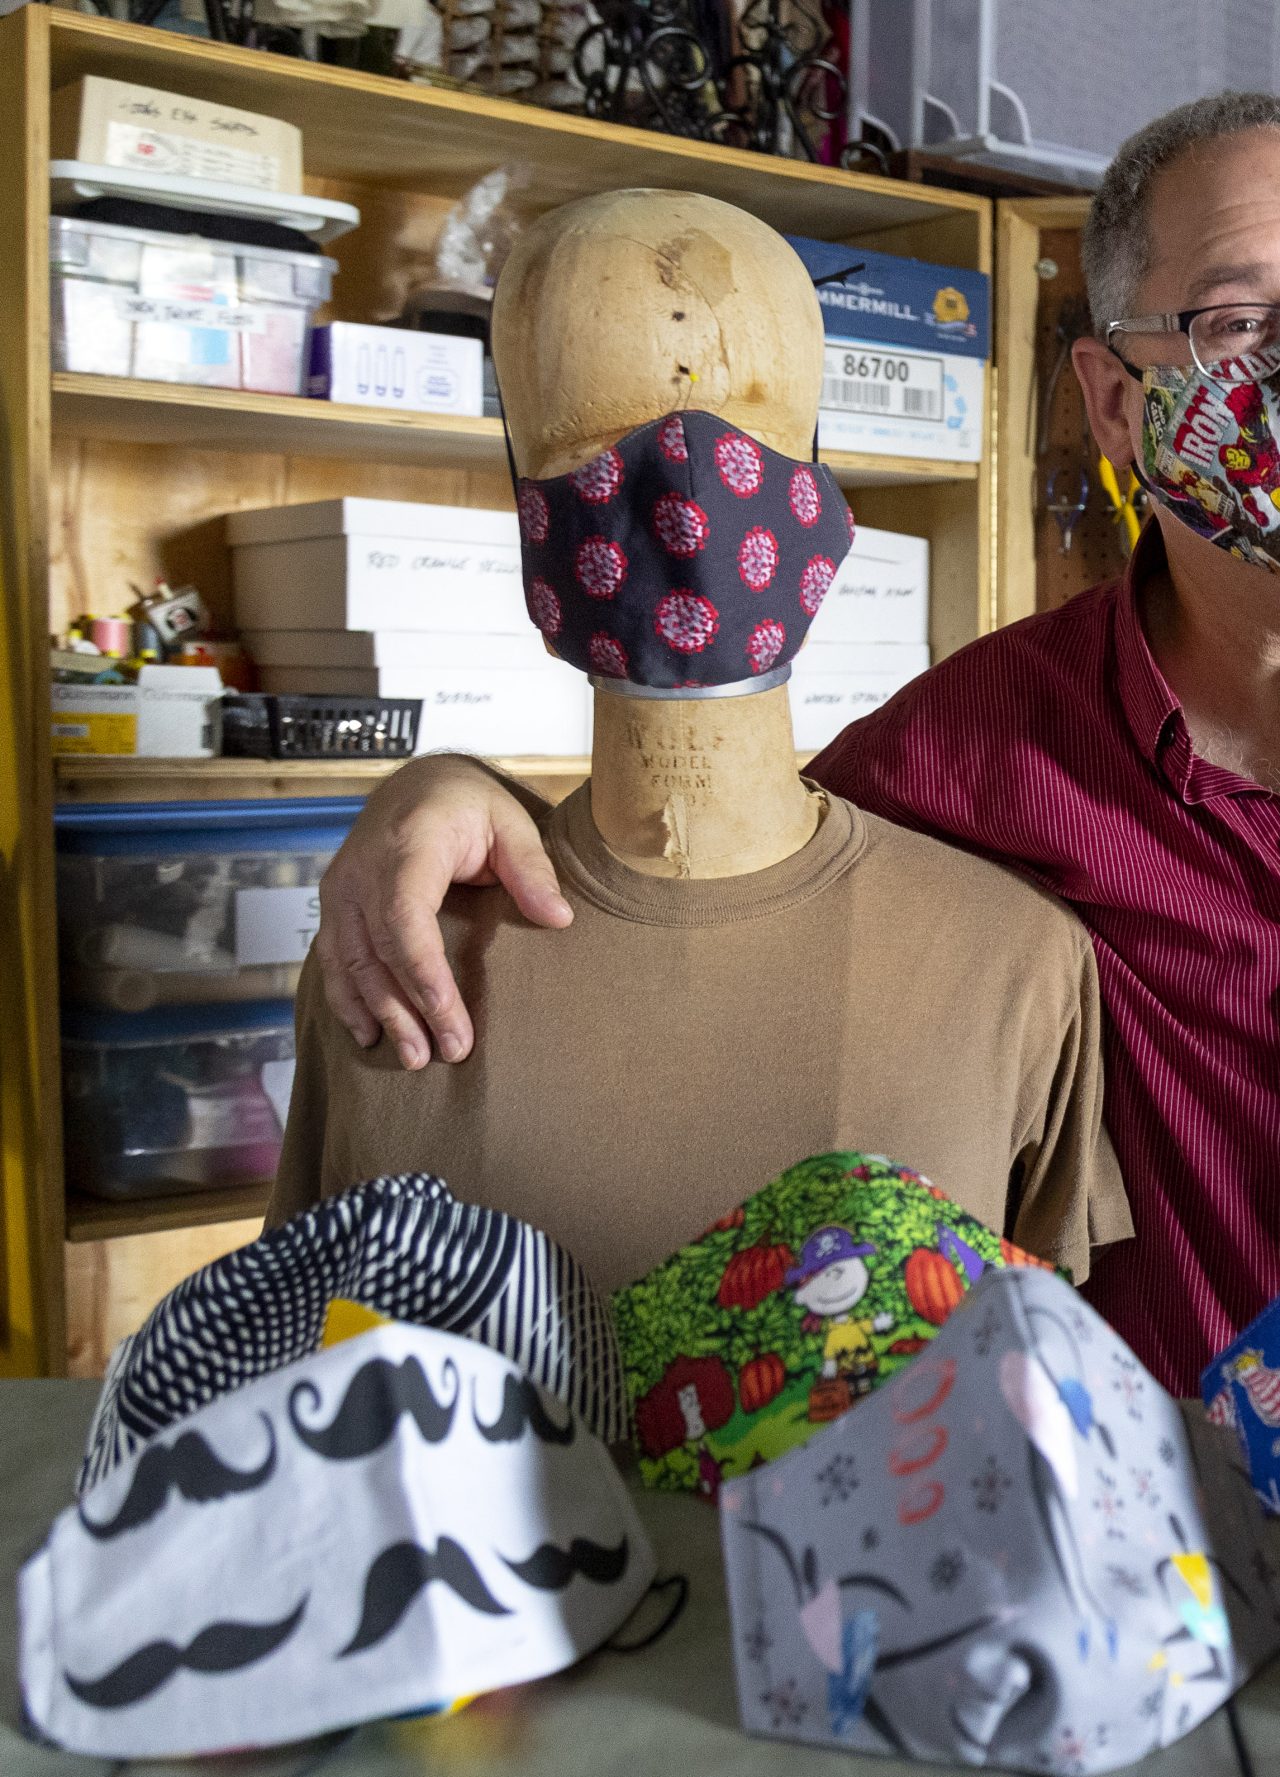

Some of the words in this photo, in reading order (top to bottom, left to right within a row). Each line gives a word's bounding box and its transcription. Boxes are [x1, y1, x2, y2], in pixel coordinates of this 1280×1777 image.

[842, 353, 910, 383] 86700
[1175, 386, 1232, 469] IRON
[640, 754, 712, 770] MODEL
[650, 773, 712, 789] FORM
